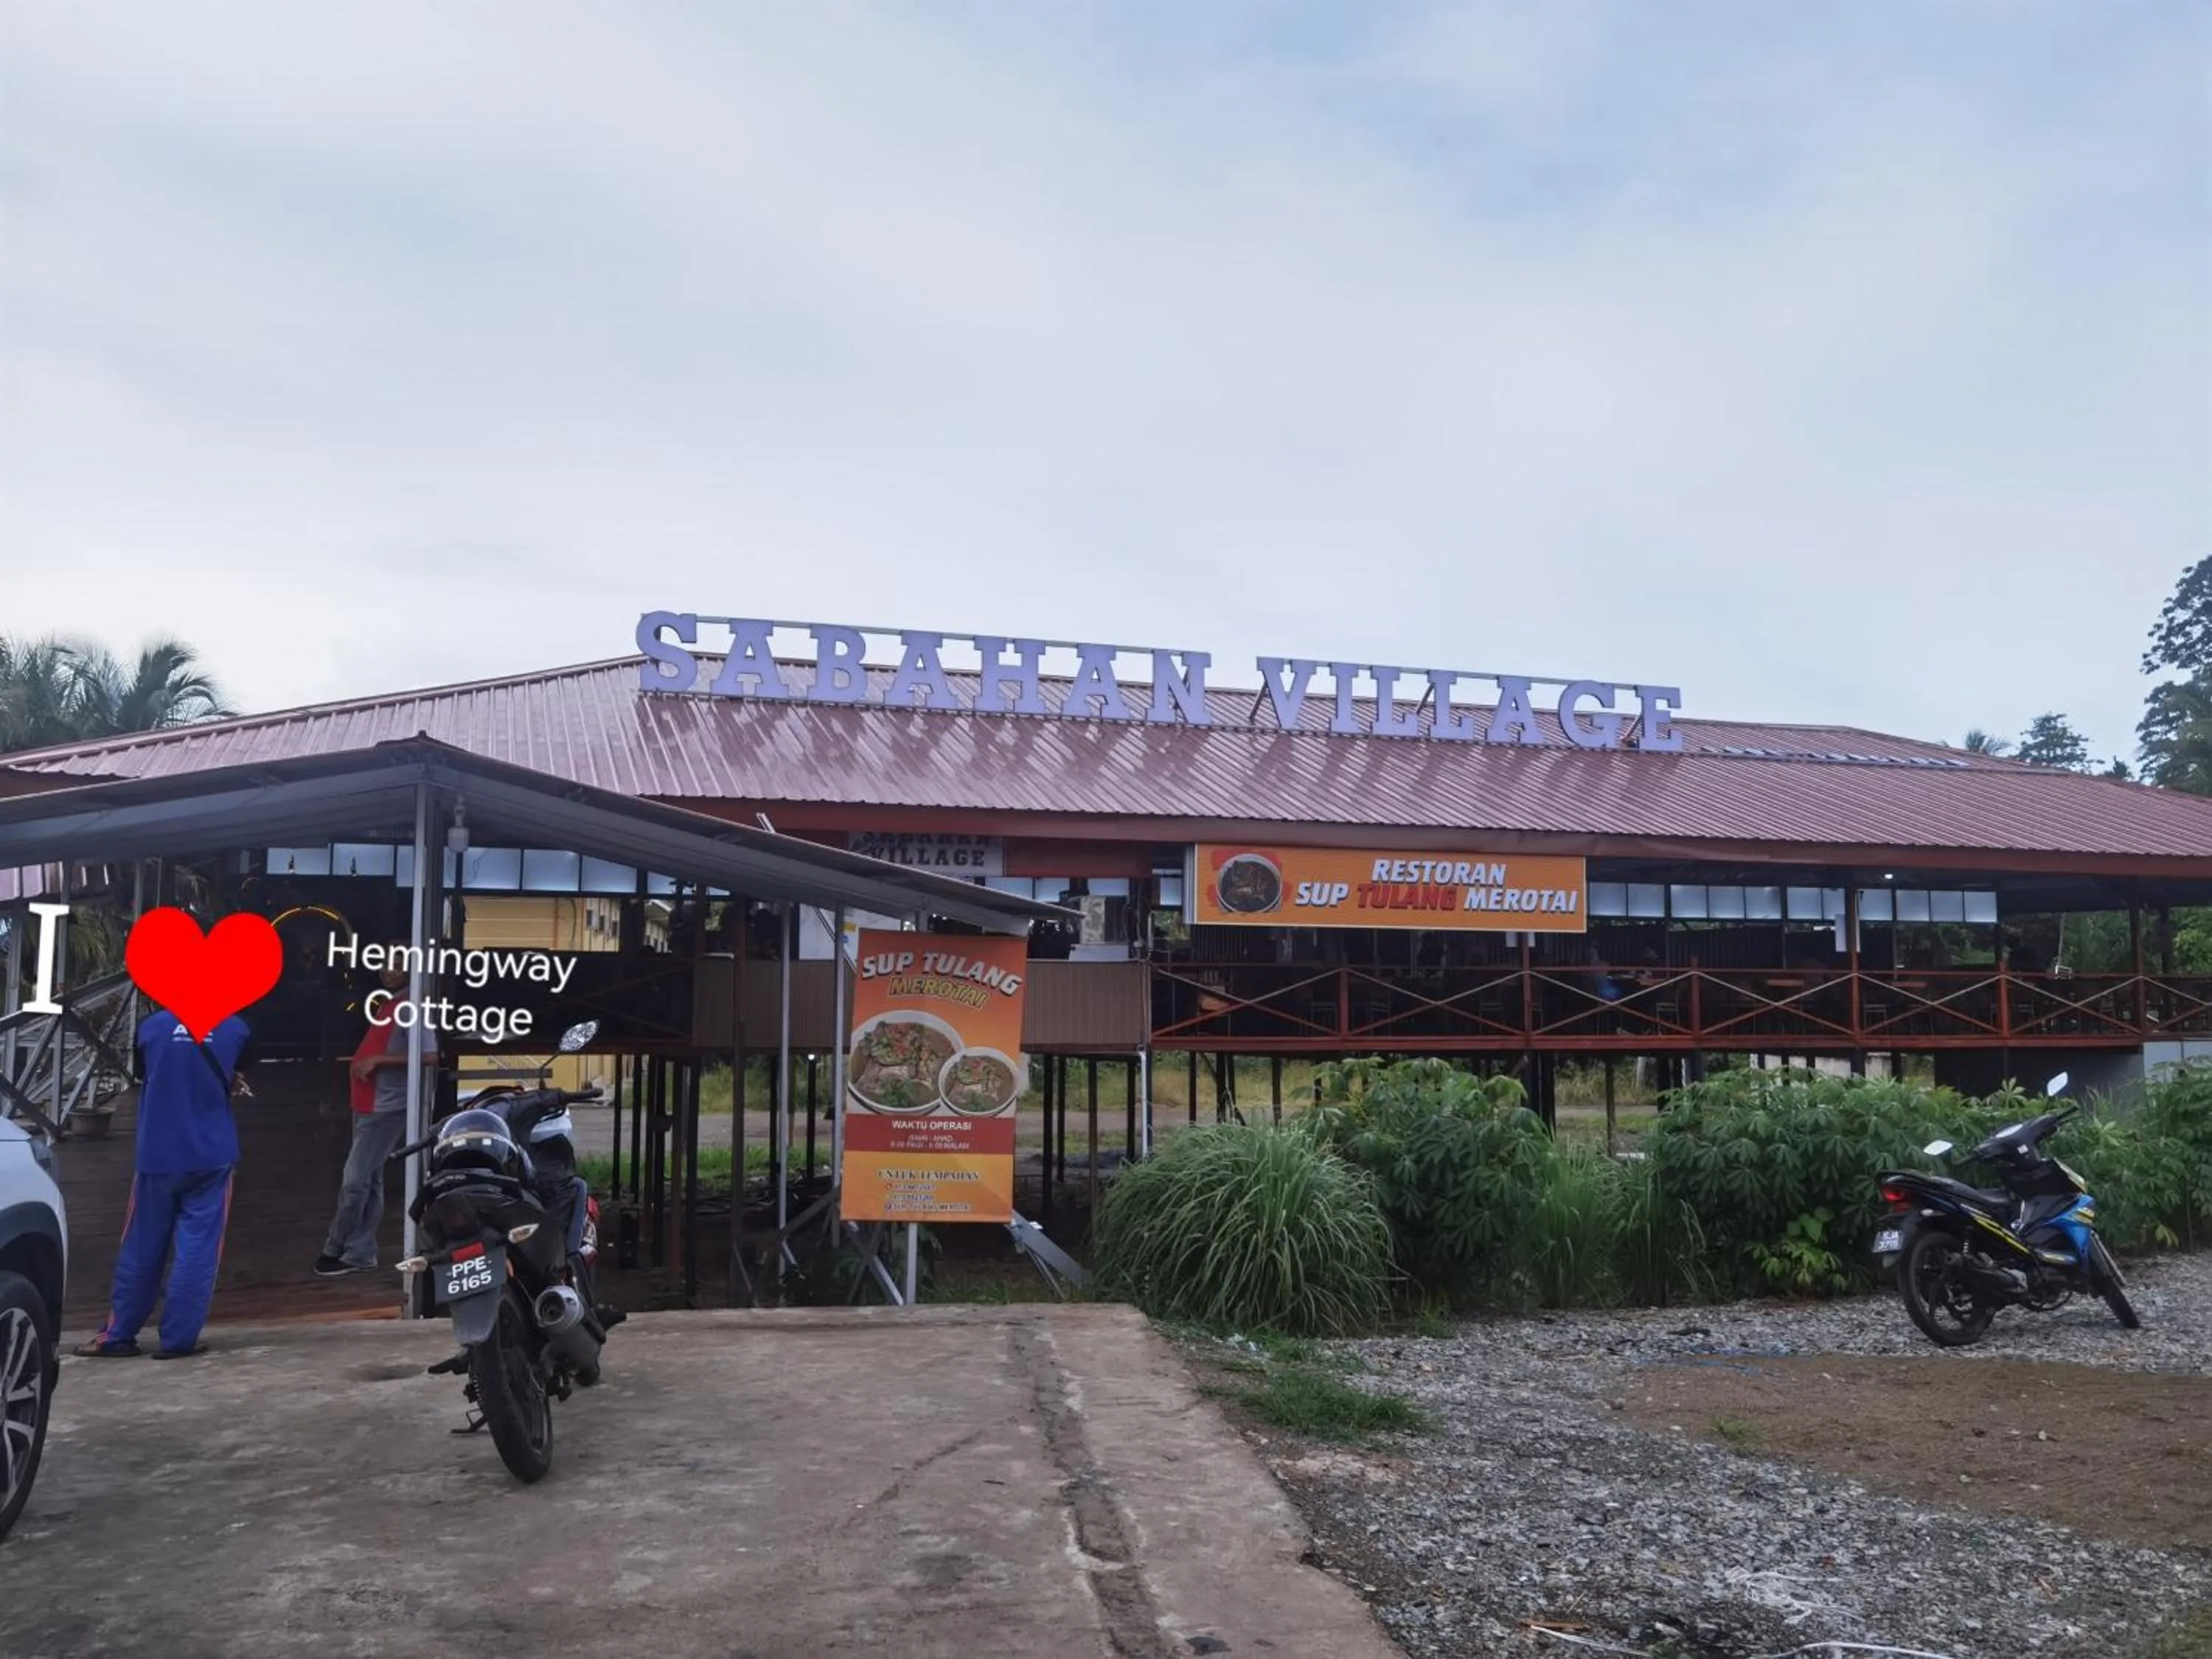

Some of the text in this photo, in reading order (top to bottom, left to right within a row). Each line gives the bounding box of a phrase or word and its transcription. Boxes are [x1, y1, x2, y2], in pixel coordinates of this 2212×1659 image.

[636, 611, 1683, 751] SABAHAN VILLAGE
[867, 848, 985, 866] VILLAGE
[1371, 859, 1506, 886] RESTORAN
[1295, 883, 1578, 914] SUP TULANG MEROTAI
[861, 952, 1023, 996] SUP TULANG
[888, 977, 990, 1009] MEROTAI
[891, 1120, 972, 1130] WAKTU OPERASI
[451, 1256, 487, 1279] PPE
[448, 1270, 492, 1294] 6165
